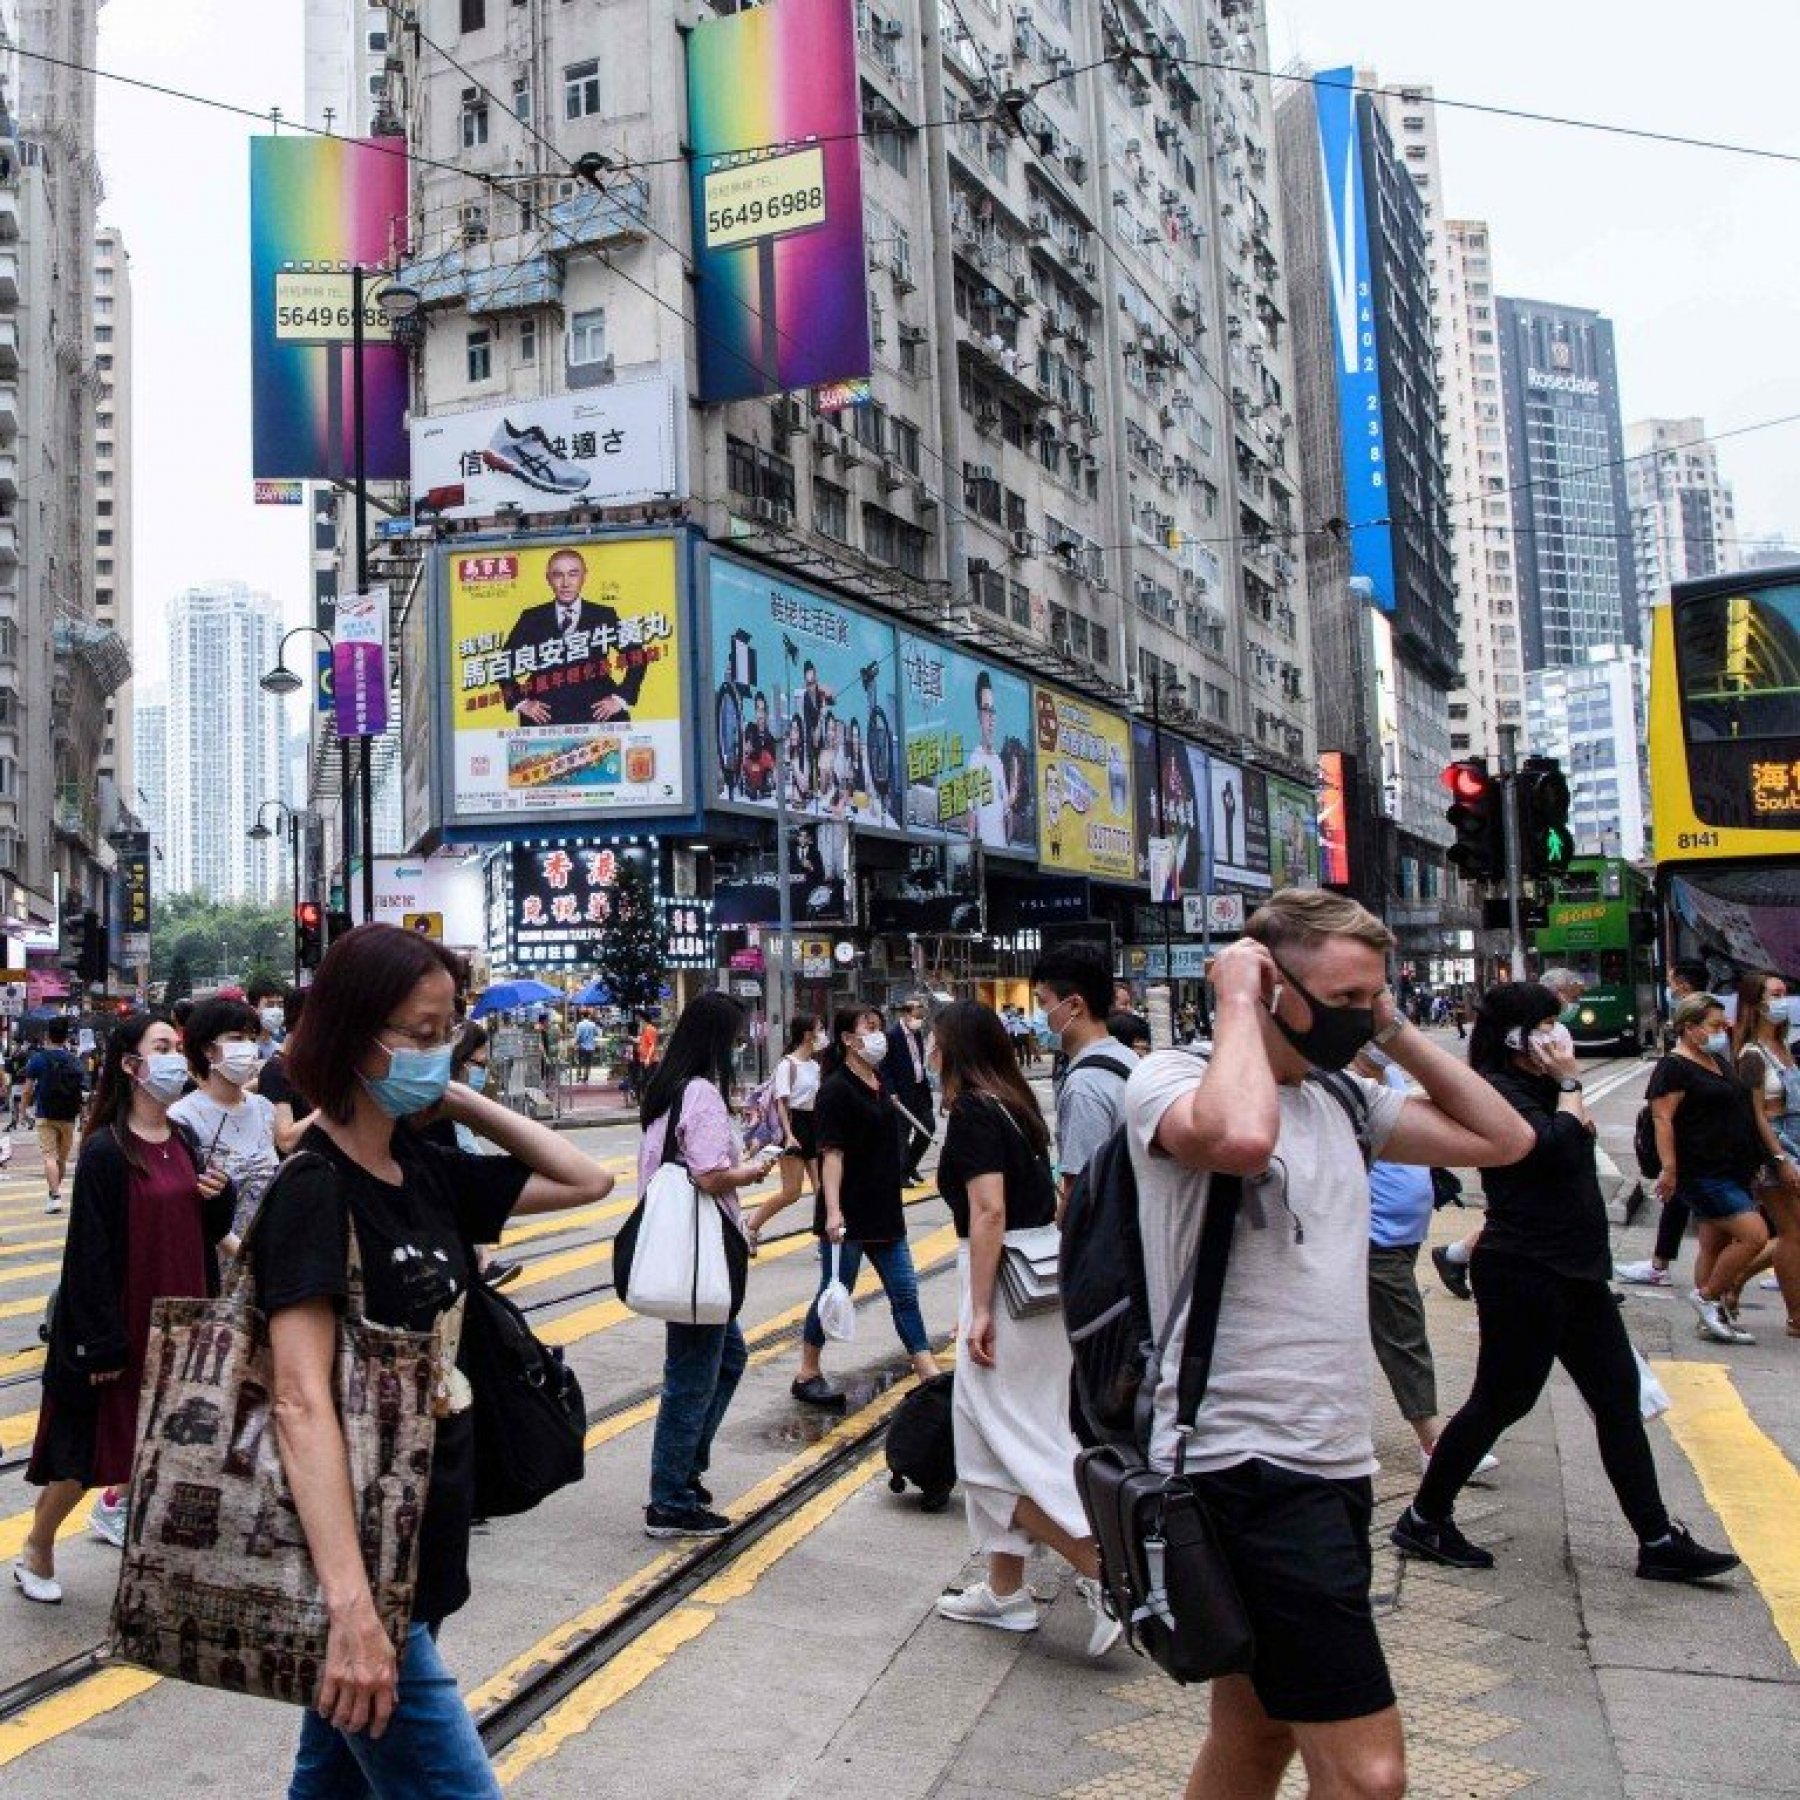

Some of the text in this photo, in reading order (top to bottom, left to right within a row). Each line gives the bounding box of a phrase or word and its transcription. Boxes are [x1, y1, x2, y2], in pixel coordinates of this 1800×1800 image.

[708, 186, 821, 233] 5649 6988
[278, 306, 390, 327] 5649 688
[1359, 282, 1383, 487] 3602 2388
[1527, 367, 1599, 396] Rosedale
[462, 612, 672, 691] 馬百良安宮牛黃丸
[1677, 832, 1719, 849] 8141
[542, 849, 618, 889] 香港
